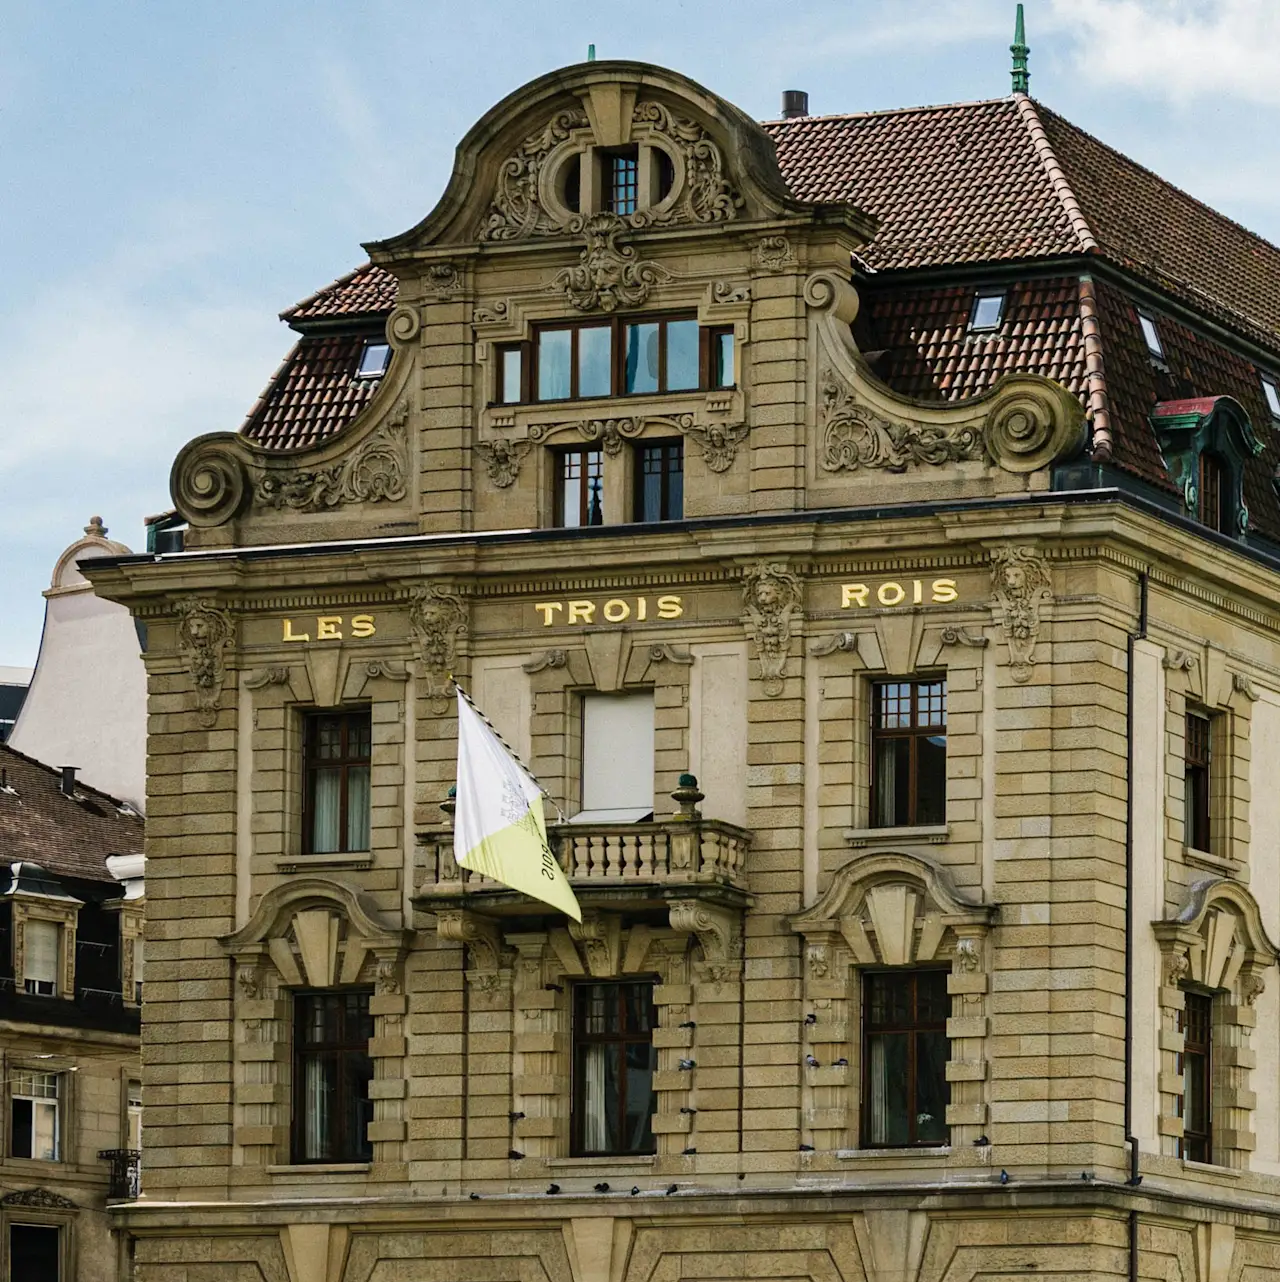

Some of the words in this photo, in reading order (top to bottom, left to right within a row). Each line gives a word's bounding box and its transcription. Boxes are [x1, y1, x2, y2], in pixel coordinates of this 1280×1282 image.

[282, 615, 376, 642] LES
[535, 595, 684, 627] TROIS
[840, 578, 959, 609] ROIS
